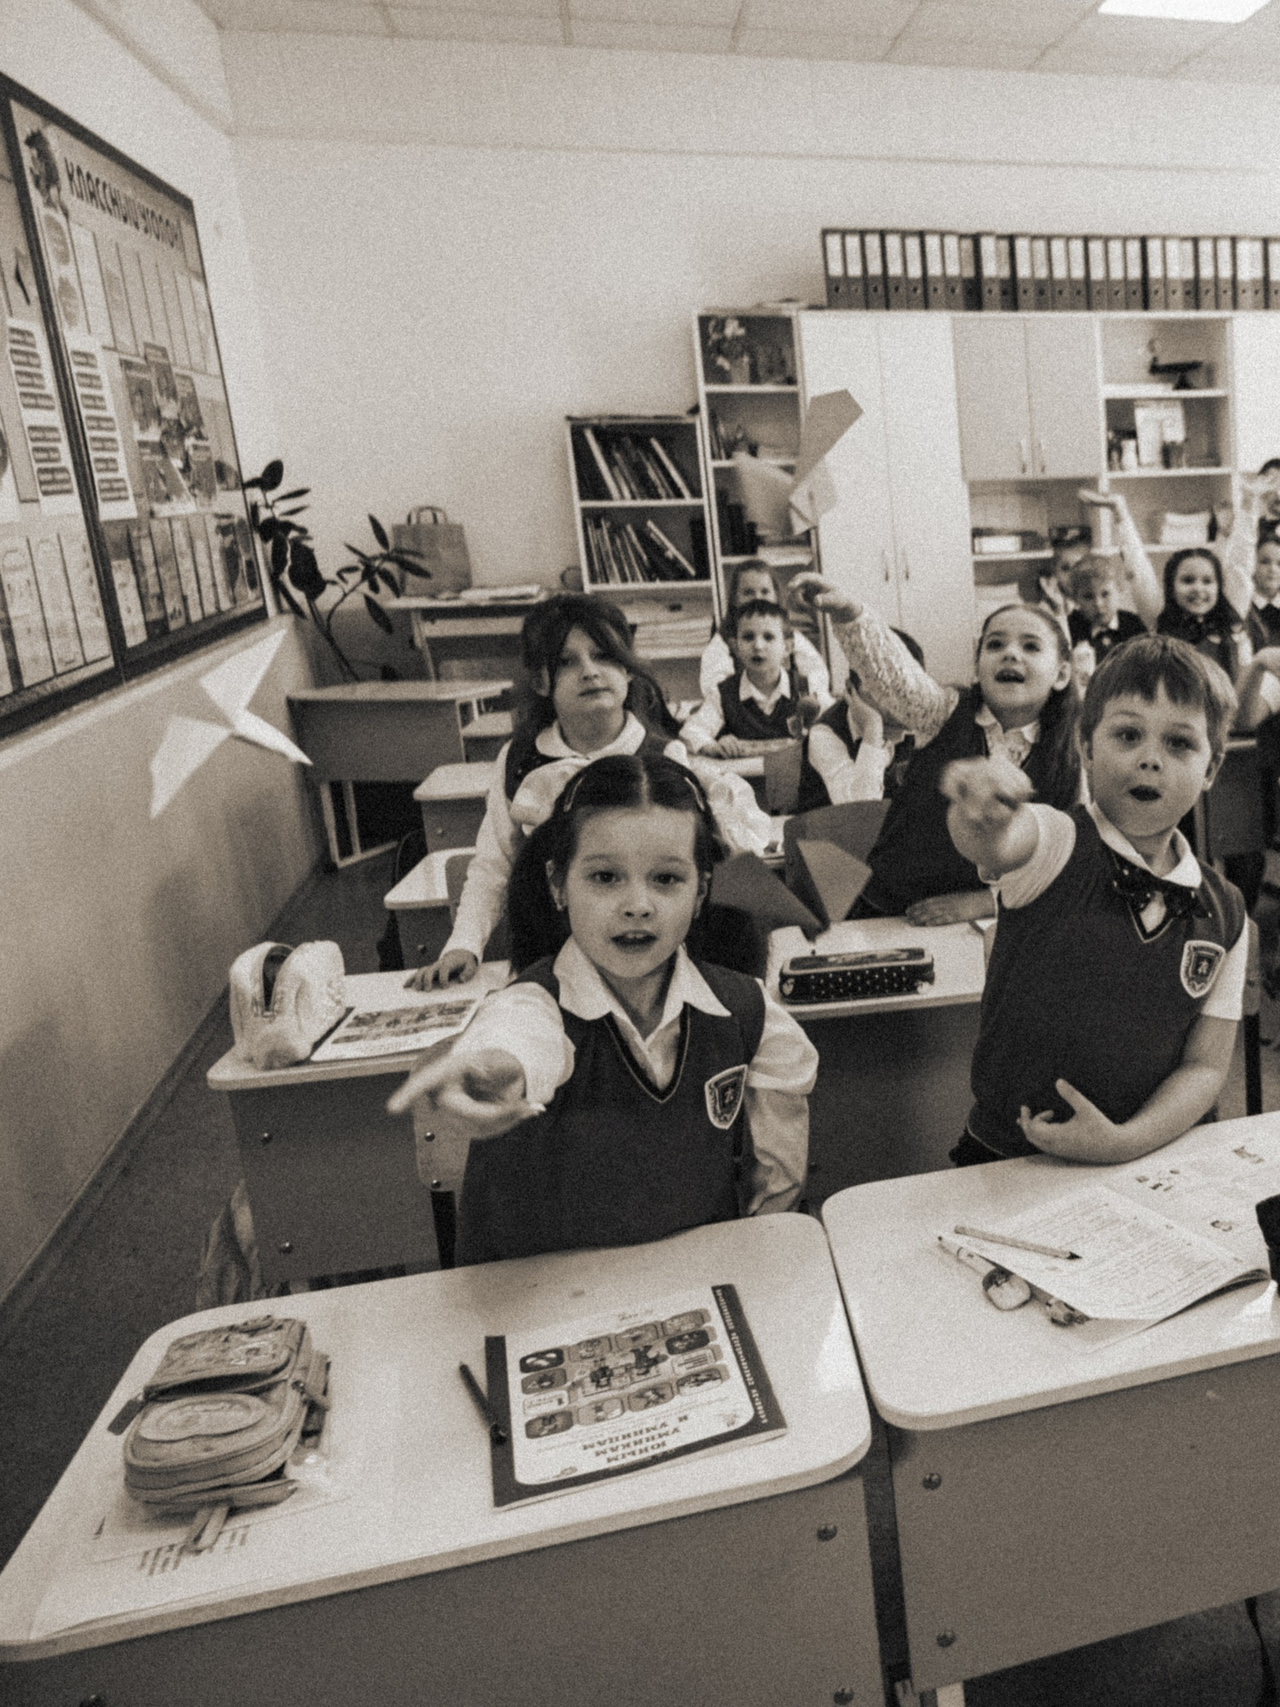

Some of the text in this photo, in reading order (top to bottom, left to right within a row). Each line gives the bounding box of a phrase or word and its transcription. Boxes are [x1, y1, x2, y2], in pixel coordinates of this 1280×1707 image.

[583, 1421, 668, 1450] УМНИЦАМ
[595, 1427, 680, 1457] УМНИКАМ
[606, 1440, 667, 1463] ЮНЫМ
